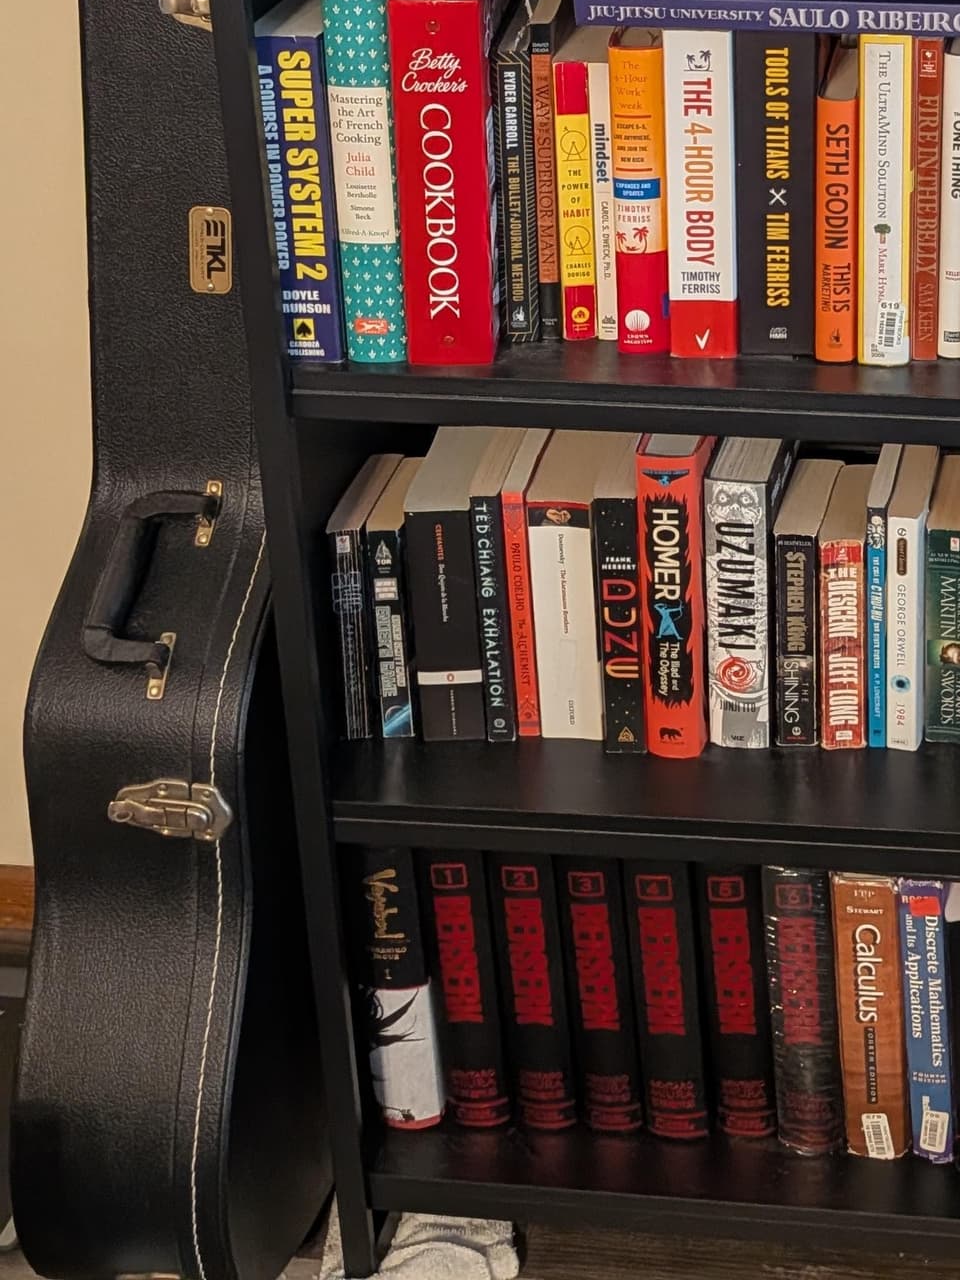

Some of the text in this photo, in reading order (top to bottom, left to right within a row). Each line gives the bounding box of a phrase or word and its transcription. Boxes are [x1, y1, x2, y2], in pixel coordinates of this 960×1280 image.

[587, 3, 666, 22] JIU-JITSU
[669, 7, 764, 22] UNIVERSITY
[768, 7, 849, 30] SAULO
[401, 72, 468, 96] Crocker's
[408, 49, 461, 77] Betty
[329, 93, 383, 107] Mastering
[332, 118, 383, 130] of French
[337, 107, 375, 118] the Art
[765, 47, 789, 180] TOOLS OF TITANS
[276, 49, 327, 281] SUPER SYSTEM 2
[336, 132, 381, 146] Cooking
[345, 151, 371, 164] Julia
[345, 165, 375, 177] Child
[567, 169, 582, 177] THE
[593, 123, 610, 183] mindset
[683, 77, 714, 265] THE 4-HOUR BODY
[419, 103, 460, 319] COOKBOOK
[561, 182, 589, 191] POWER
[562, 208, 590, 218] HABIT
[570, 196, 581, 204] OF
[824, 123, 848, 249] SETH GODIN
[765, 213, 790, 306] TIM FERRISS
[474, 505, 493, 598] TED CHIANG
[652, 508, 681, 599] HOMER
[715, 521, 756, 649] UZUMAKI
[783, 552, 806, 651] STEPHEN KING
[896, 584, 905, 667] GEORGE ORWELL
[482, 608, 503, 707] EXHALATION
[783, 661, 800, 723] SHINING
[855, 924, 884, 1022] Calculus
[904, 914, 926, 1038] and Its Applications
[924, 915, 945, 1066] Discrete Mathematics
